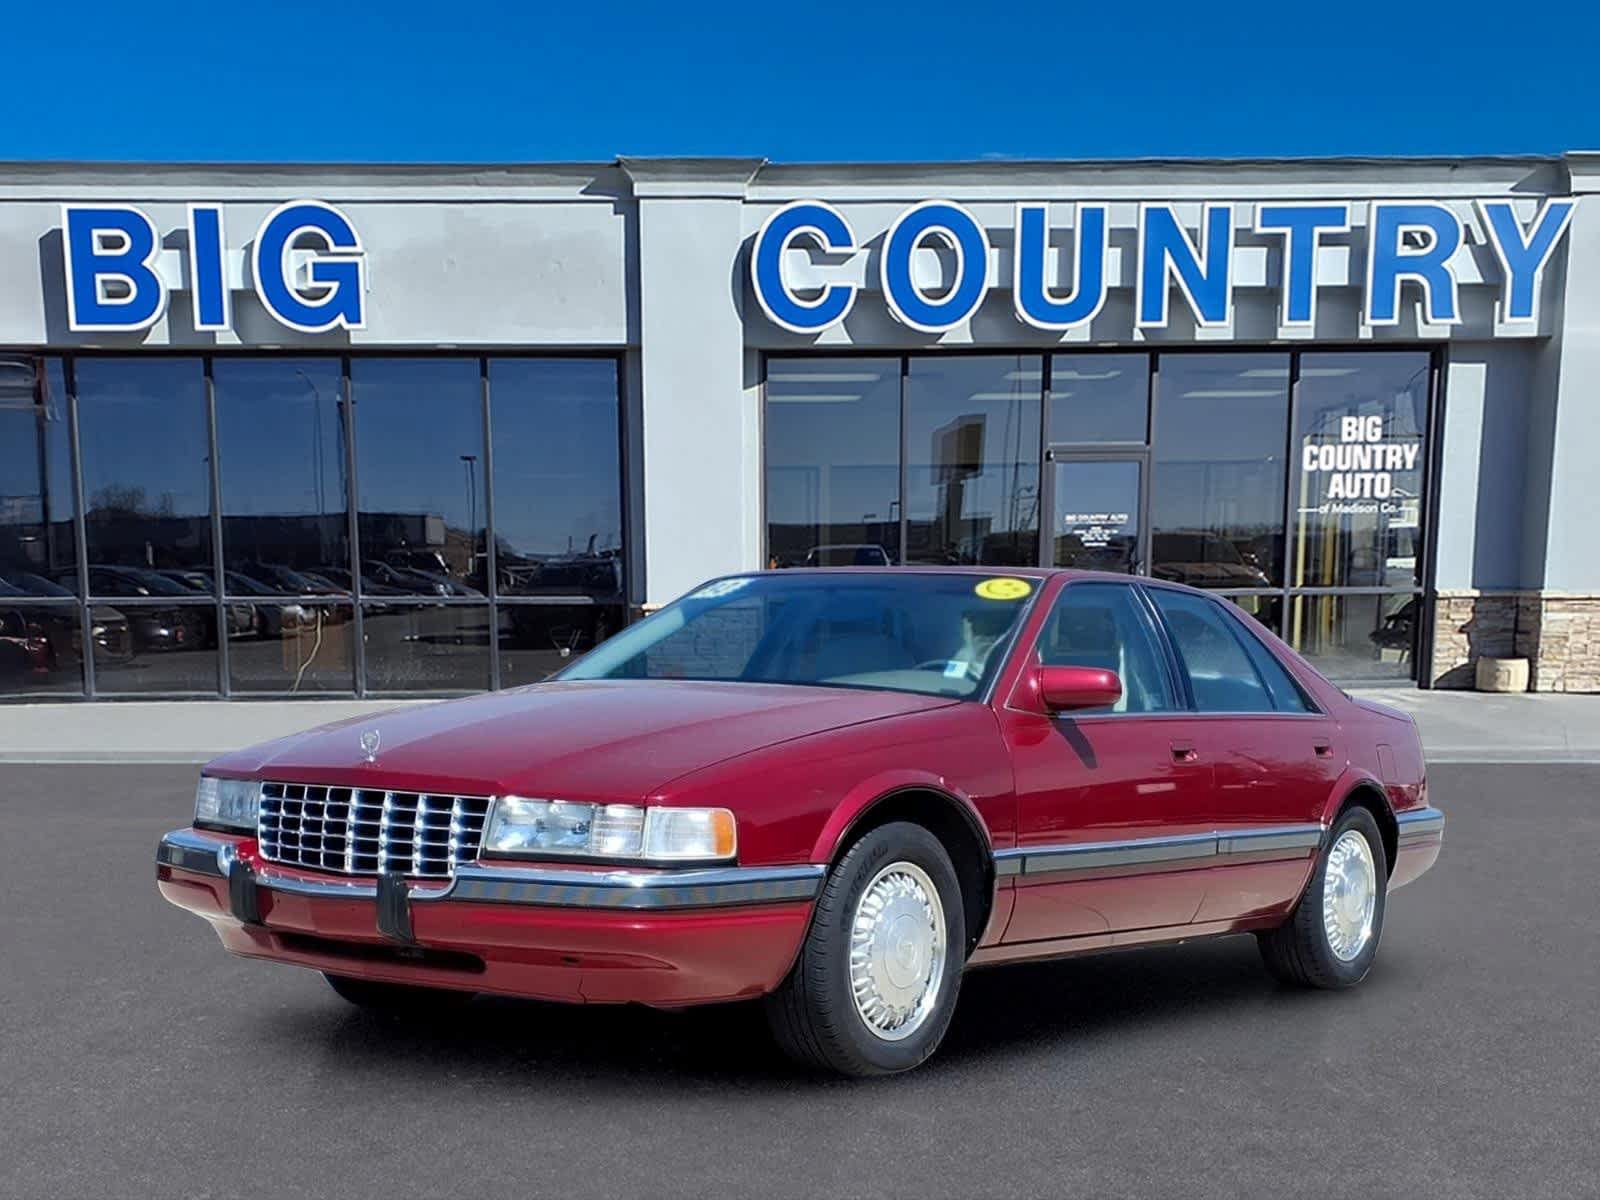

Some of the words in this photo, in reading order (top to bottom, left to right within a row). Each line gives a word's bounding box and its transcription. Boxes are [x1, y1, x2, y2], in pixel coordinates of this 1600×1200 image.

[61, 199, 366, 333] BIG
[751, 198, 1577, 333] COUNTRY
[1341, 415, 1383, 443] BIG
[1302, 443, 1420, 472] COUNTRY
[1327, 472, 1392, 499] AUTO
[1331, 503, 1378, 514] Madison
